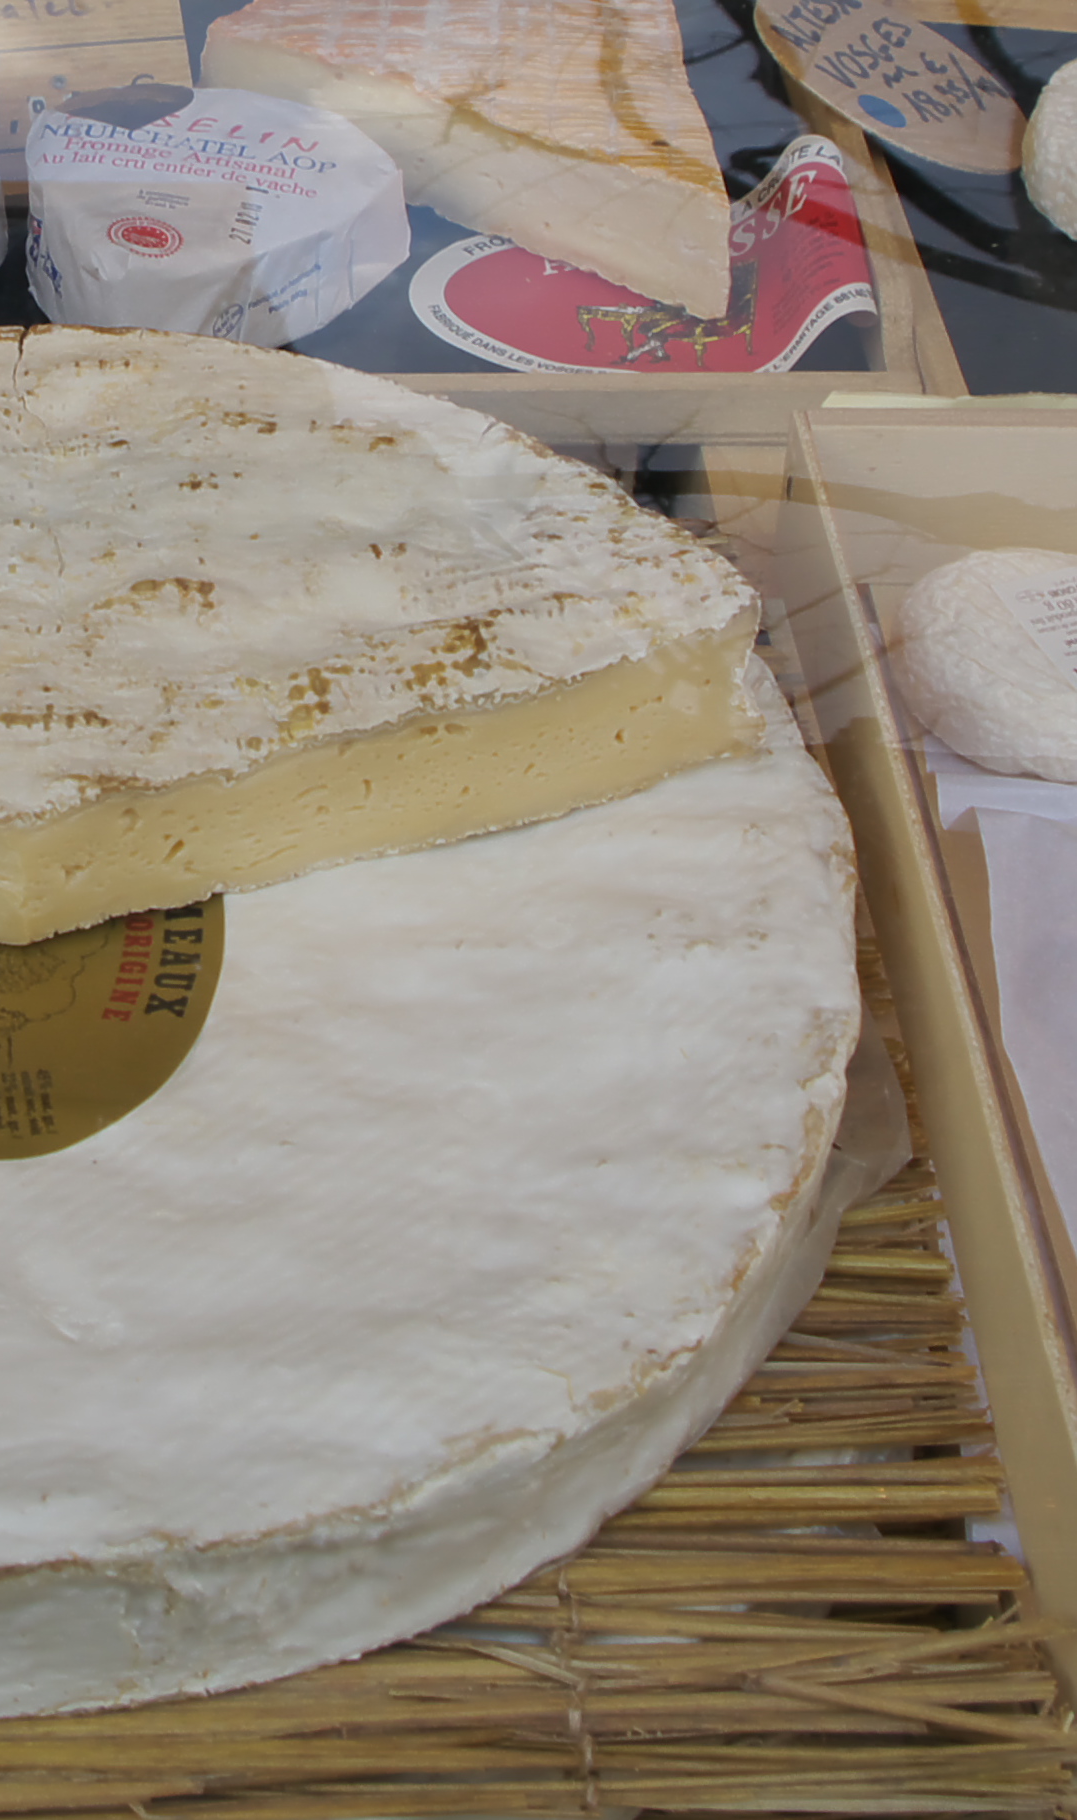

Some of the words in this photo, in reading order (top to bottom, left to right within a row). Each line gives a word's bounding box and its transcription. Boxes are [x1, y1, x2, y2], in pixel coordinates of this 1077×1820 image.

[40, 123, 257, 160] NEUFCHATEL
[267, 151, 337, 174] AOP
[64, 137, 173, 160] Fromage
[183, 151, 298, 181] Artisanal
[34, 152, 65, 168] Au
[72, 151, 107, 165] lait
[111, 156, 146, 170] cru
[152, 159, 217, 178] entier
[221, 170, 248, 184] de
[255, 177, 318, 199] vache
[462, 235, 515, 257] FRO
[428, 303, 476, 342] FABRIQUÉ
[472, 336, 508, 358] DANS
[507, 351, 535, 367] LES
